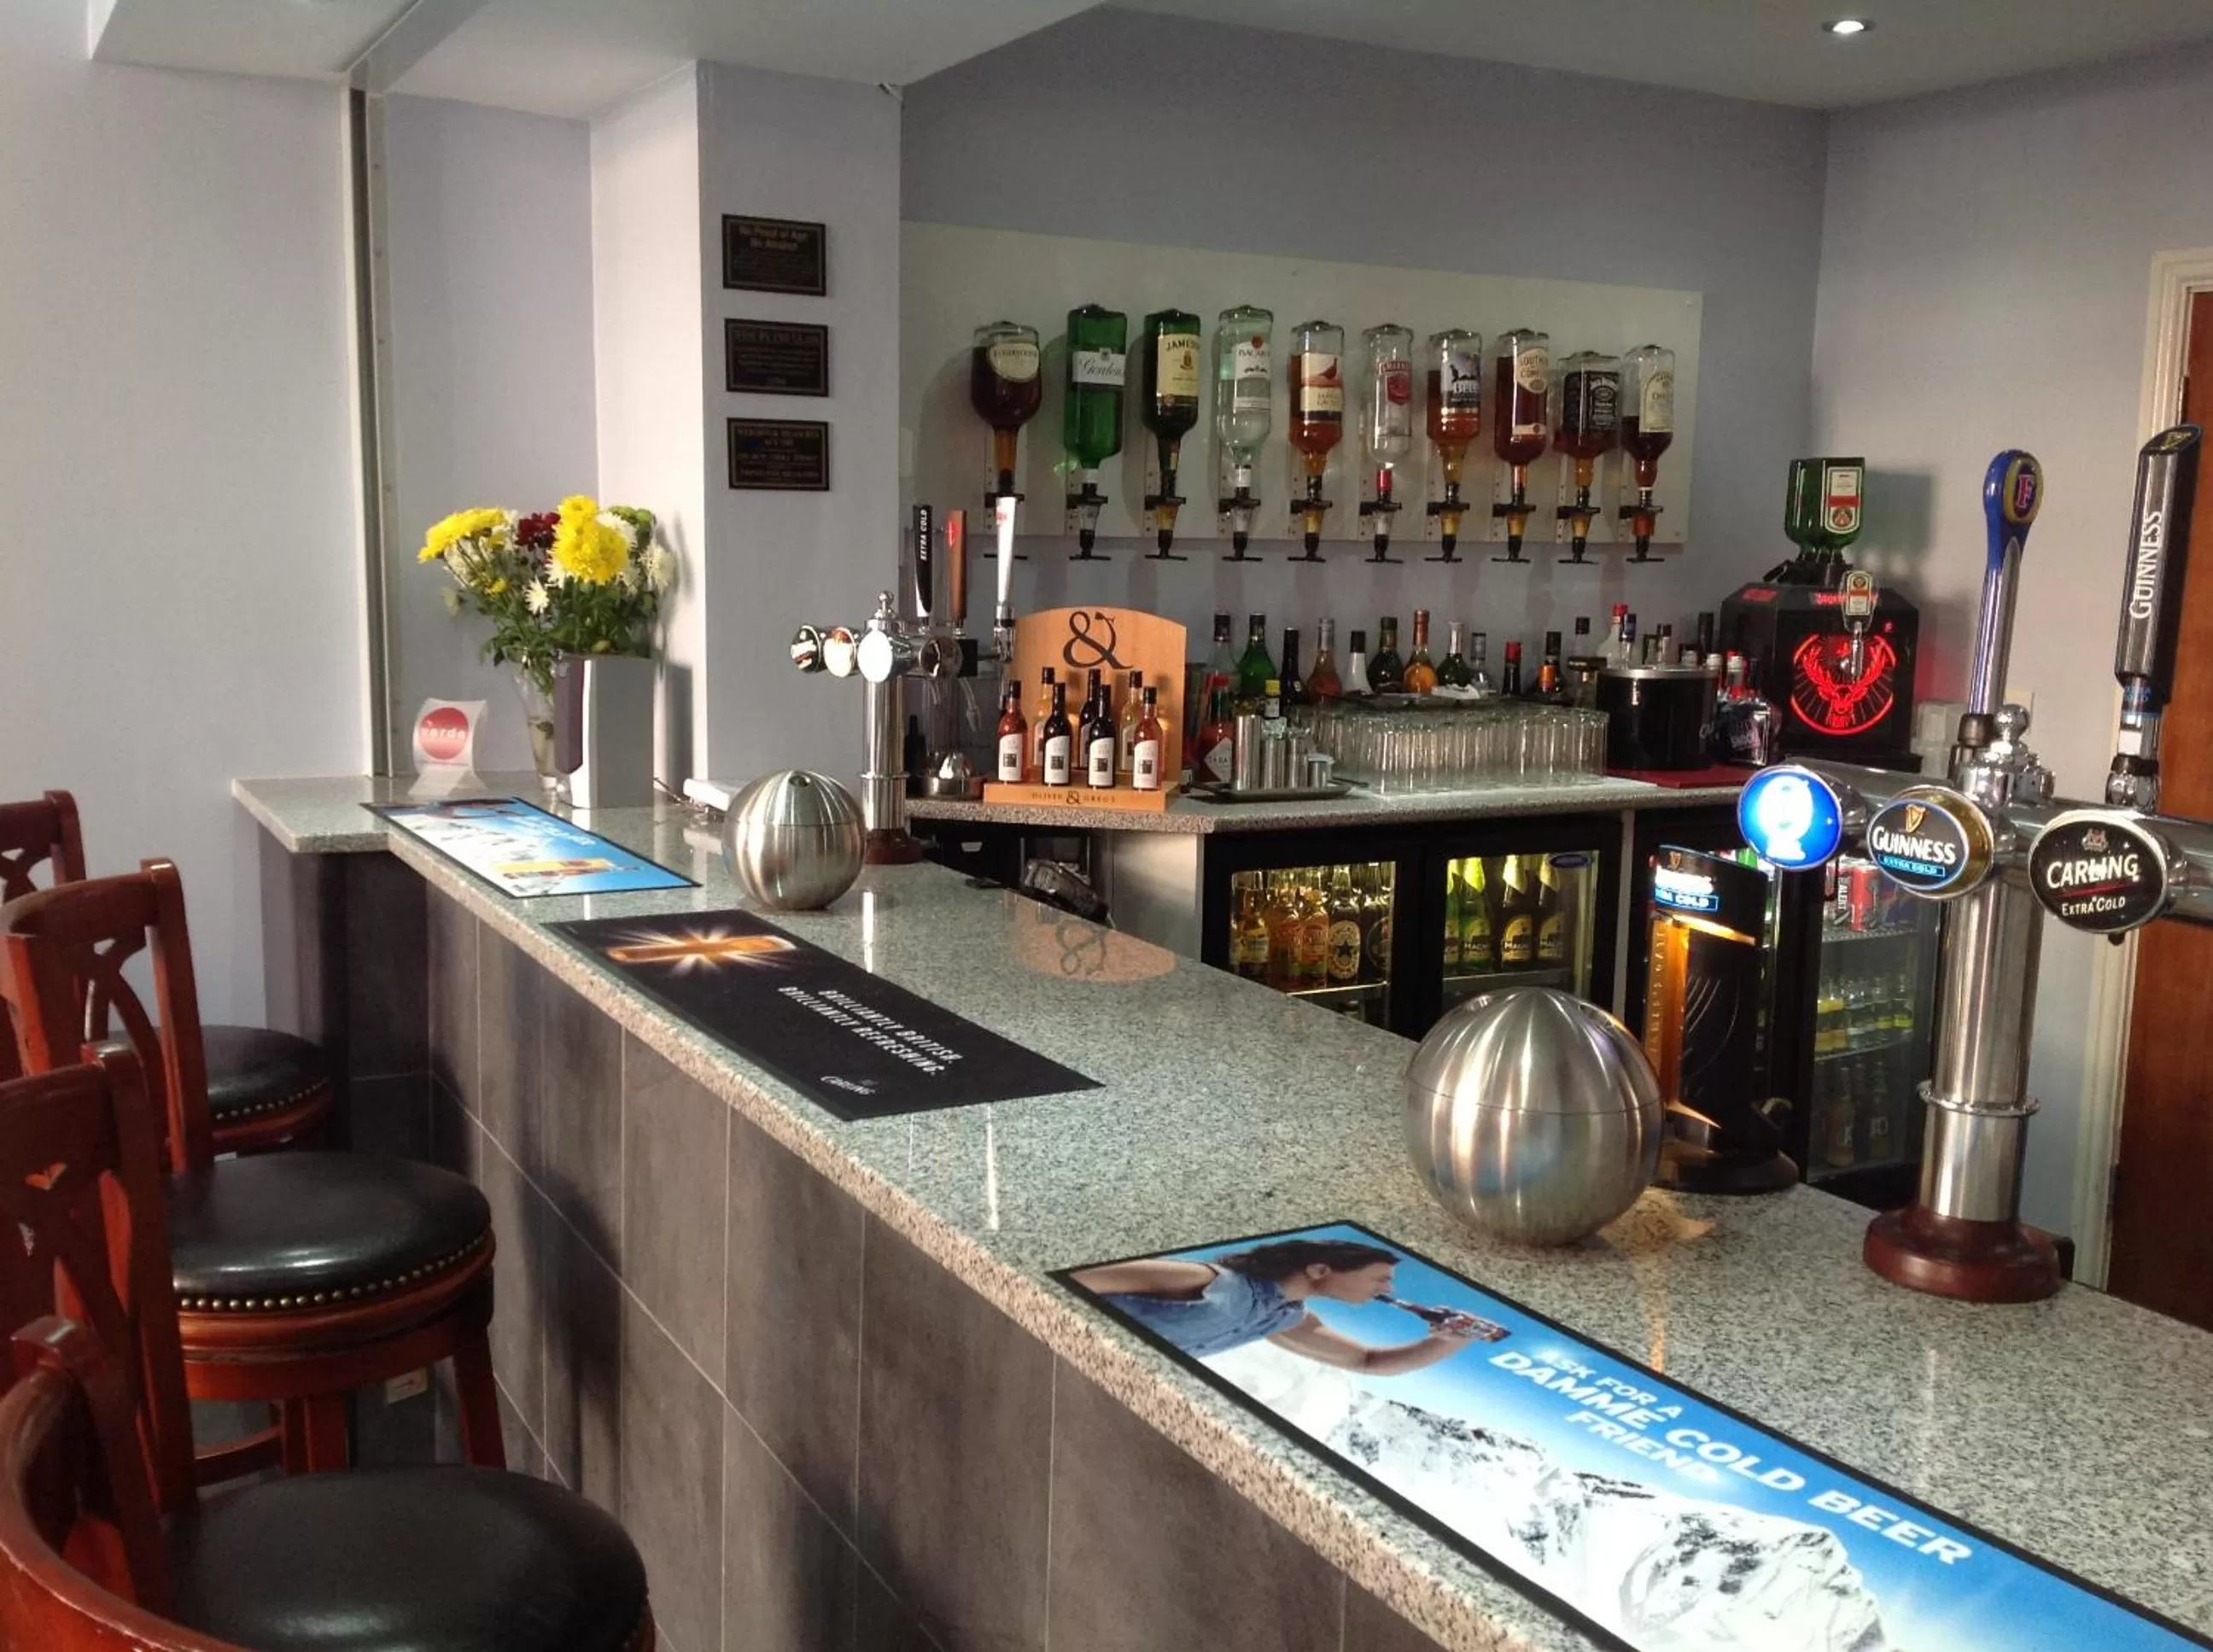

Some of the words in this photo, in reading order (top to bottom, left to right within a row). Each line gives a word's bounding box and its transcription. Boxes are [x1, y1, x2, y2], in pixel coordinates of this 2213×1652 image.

[2017, 475, 2035, 510] F
[2130, 511, 2163, 619] GUINNESS
[1871, 825, 1957, 866] GUINNESS
[2047, 854, 2139, 889] CARLING
[2096, 896, 2126, 912] COLD
[778, 986, 861, 1025] BRILLIANTLY
[818, 989, 904, 1030] BRILLIANTLY
[1595, 1376, 1658, 1406] FOR
[1656, 1404, 1683, 1419] A
[1489, 1351, 1667, 1430] DAMME
[1666, 1428, 1806, 1492] COLD
[1808, 1490, 1972, 1565] BEER
[1564, 1410, 1720, 1481] FRIEND
